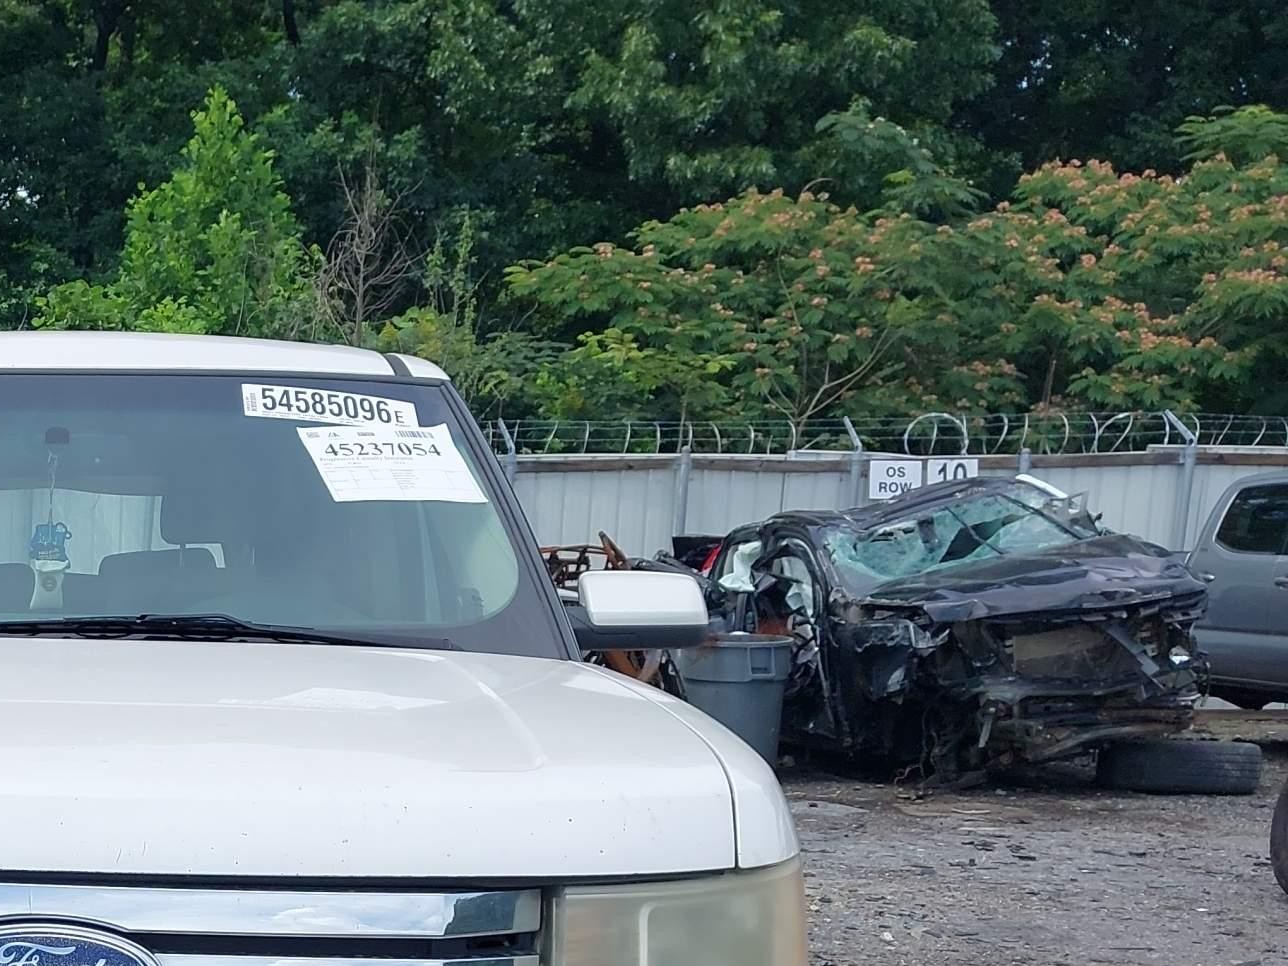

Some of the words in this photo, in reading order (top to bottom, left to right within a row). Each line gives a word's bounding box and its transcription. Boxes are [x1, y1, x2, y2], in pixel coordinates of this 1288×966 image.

[261, 387, 392, 423] 54585096
[325, 442, 442, 457] 45237054
[886, 466, 906, 478] OS
[938, 462, 967, 480] 10
[878, 482, 912, 493] ROW
